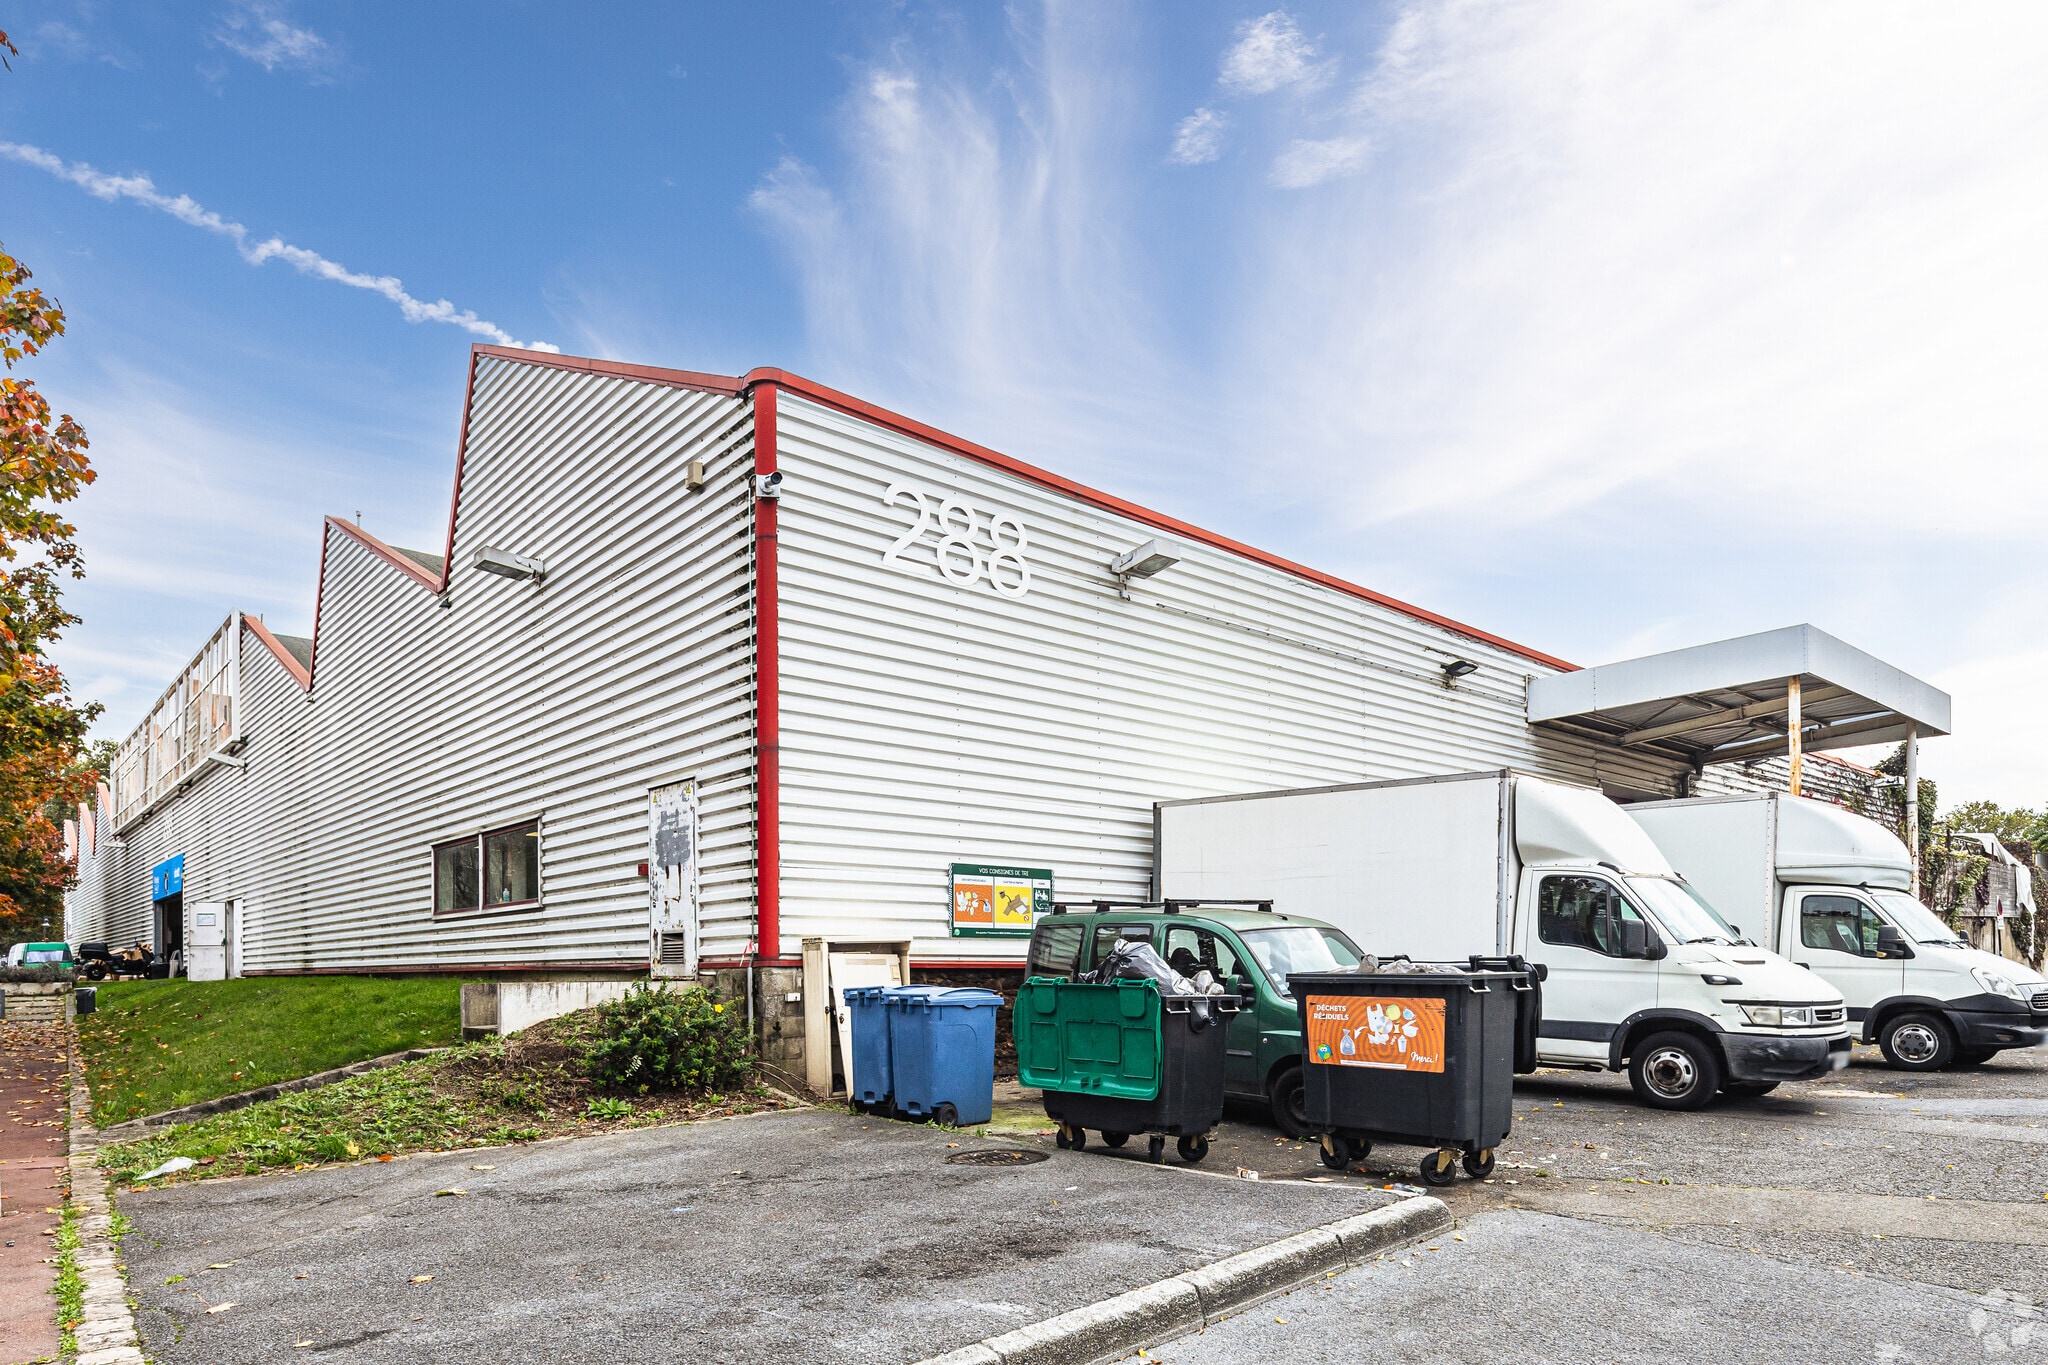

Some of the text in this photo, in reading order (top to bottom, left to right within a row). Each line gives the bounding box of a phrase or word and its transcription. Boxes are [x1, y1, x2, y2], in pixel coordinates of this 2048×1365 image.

[883, 481, 1031, 599] 288
[1316, 1003, 1347, 1012] DÉCHETS
[1410, 1051, 1434, 1064] Merci
